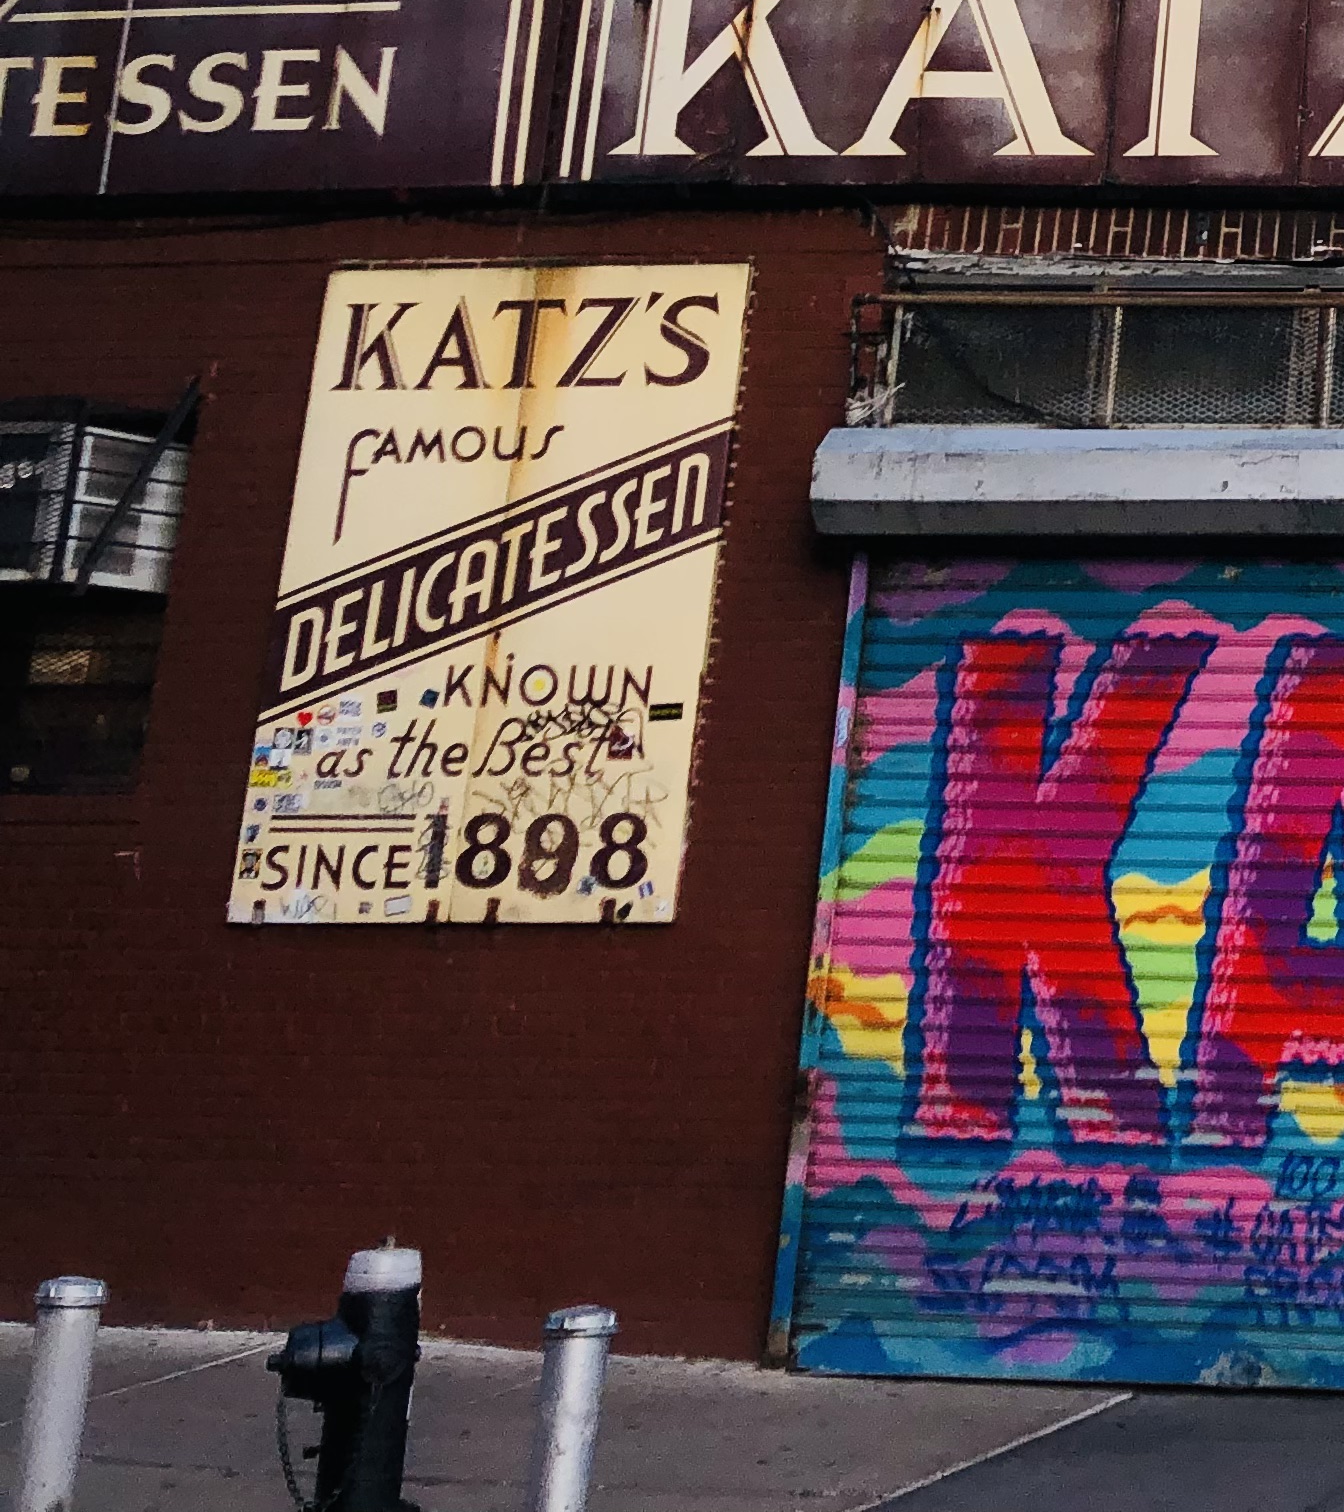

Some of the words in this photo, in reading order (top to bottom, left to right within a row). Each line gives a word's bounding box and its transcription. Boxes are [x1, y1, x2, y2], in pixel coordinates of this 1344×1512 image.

[330, 291, 720, 391] KATZ'S
[280, 451, 712, 692] DELICATESSEN
[442, 664, 653, 709] KNOWN
[316, 747, 374, 779] as
[387, 718, 470, 780] the
[471, 717, 612, 779] Best
[259, 843, 413, 892] SINCE
